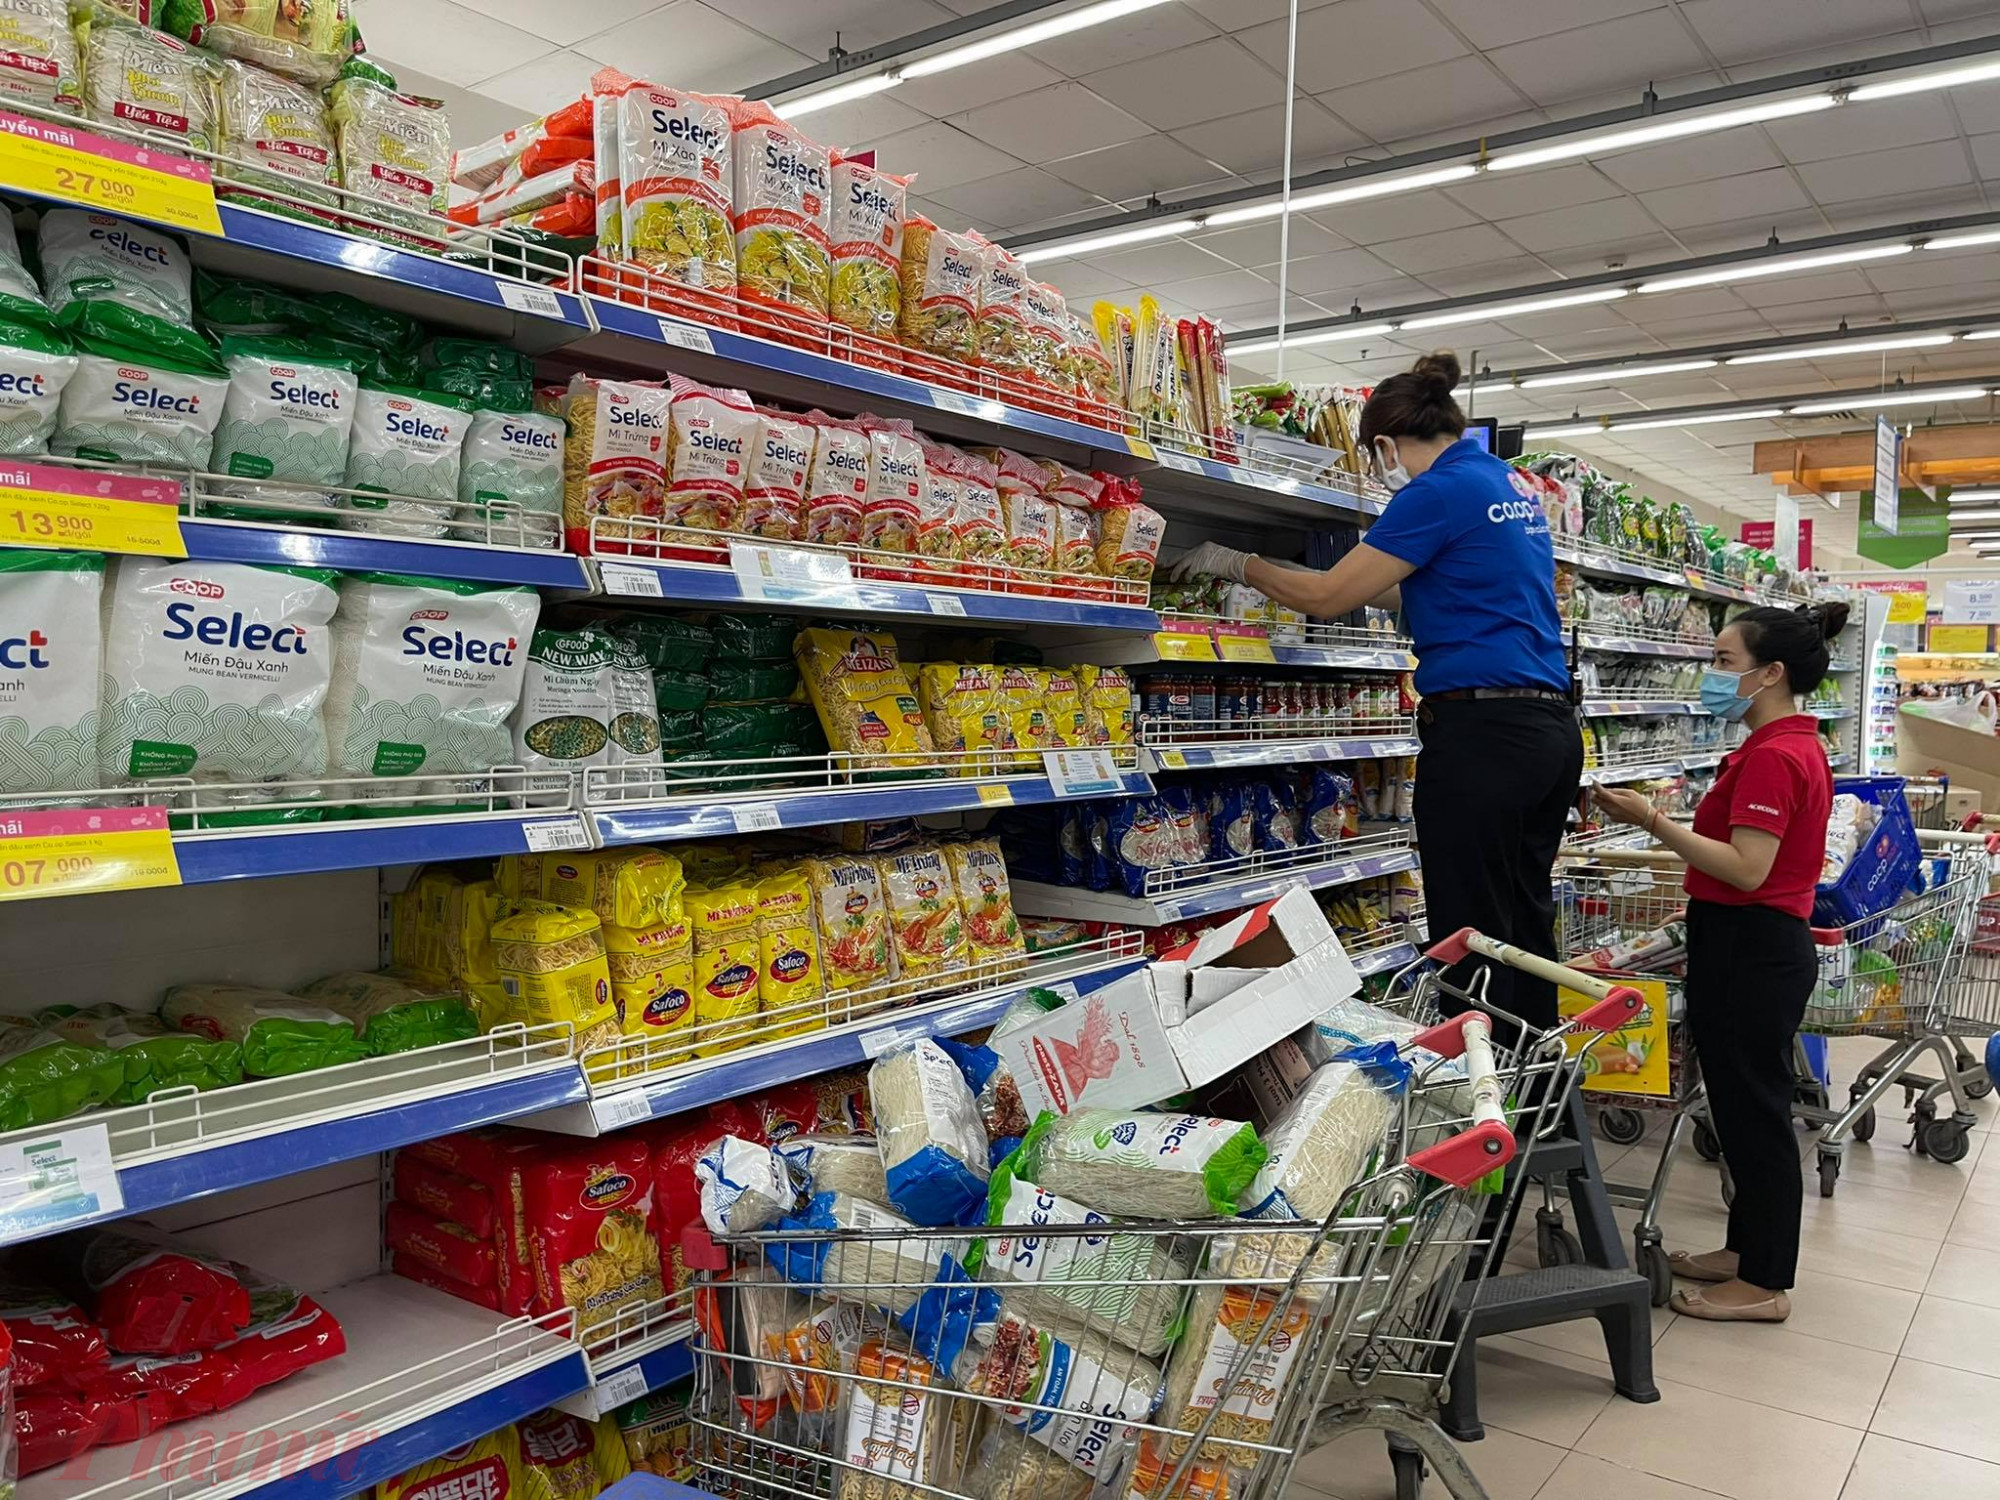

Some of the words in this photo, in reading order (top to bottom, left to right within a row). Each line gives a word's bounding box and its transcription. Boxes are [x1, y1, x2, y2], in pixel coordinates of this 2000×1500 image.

[651, 94, 677, 108] COOP
[155, 109, 181, 127] Tiệc
[43, 130, 75, 147] mãi
[652, 109, 724, 152] Select
[766, 145, 826, 190] Select
[55, 167, 95, 194] 27
[101, 178, 135, 197] 000
[942, 256, 972, 279] Select
[118, 368, 149, 380] COOP
[112, 382, 200, 414] Select
[270, 380, 339, 410] Select
[386, 413, 449, 442] Select
[501, 424, 558, 450] Select
[608, 428, 621, 439] Mì
[624, 430, 649, 445] Trứng
[690, 429, 742, 454] Select
[766, 440, 807, 467] Select
[827, 450, 867, 473] Select
[880, 456, 919, 478] Select
[10, 510, 53, 535] 13
[57, 515, 93, 531] 900
[171, 578, 224, 599] COOP
[410, 610, 448, 620] COOP
[162, 602, 308, 655] Select
[402, 626, 517, 667] Select
[560, 640, 589, 650] GFOOD
[184, 650, 220, 666] Miến
[224, 656, 253, 671] Đậu
[256, 658, 289, 673] Xanh
[542, 647, 571, 665] NEW
[845, 656, 893, 673] MEIZAN
[188, 666, 214, 677] MUNG
[215, 669, 238, 680] BEAN
[239, 671, 281, 683] VERMICELLI
[423, 663, 451, 678] Miến
[454, 667, 474, 681] Đậu
[476, 670, 496, 682] Xanh
[955, 678, 989, 691] MEIZAN
[4, 859, 46, 887] 07
[57, 856, 93, 873] 000
[777, 954, 806, 971] Safoco
[715, 968, 749, 987] Safoco
[651, 993, 687, 1013] Safoco
[770, 1124, 799, 1140] Safoco
[588, 1178, 628, 1199] Safoco
[1014, 1187, 1057, 1268] Seect
